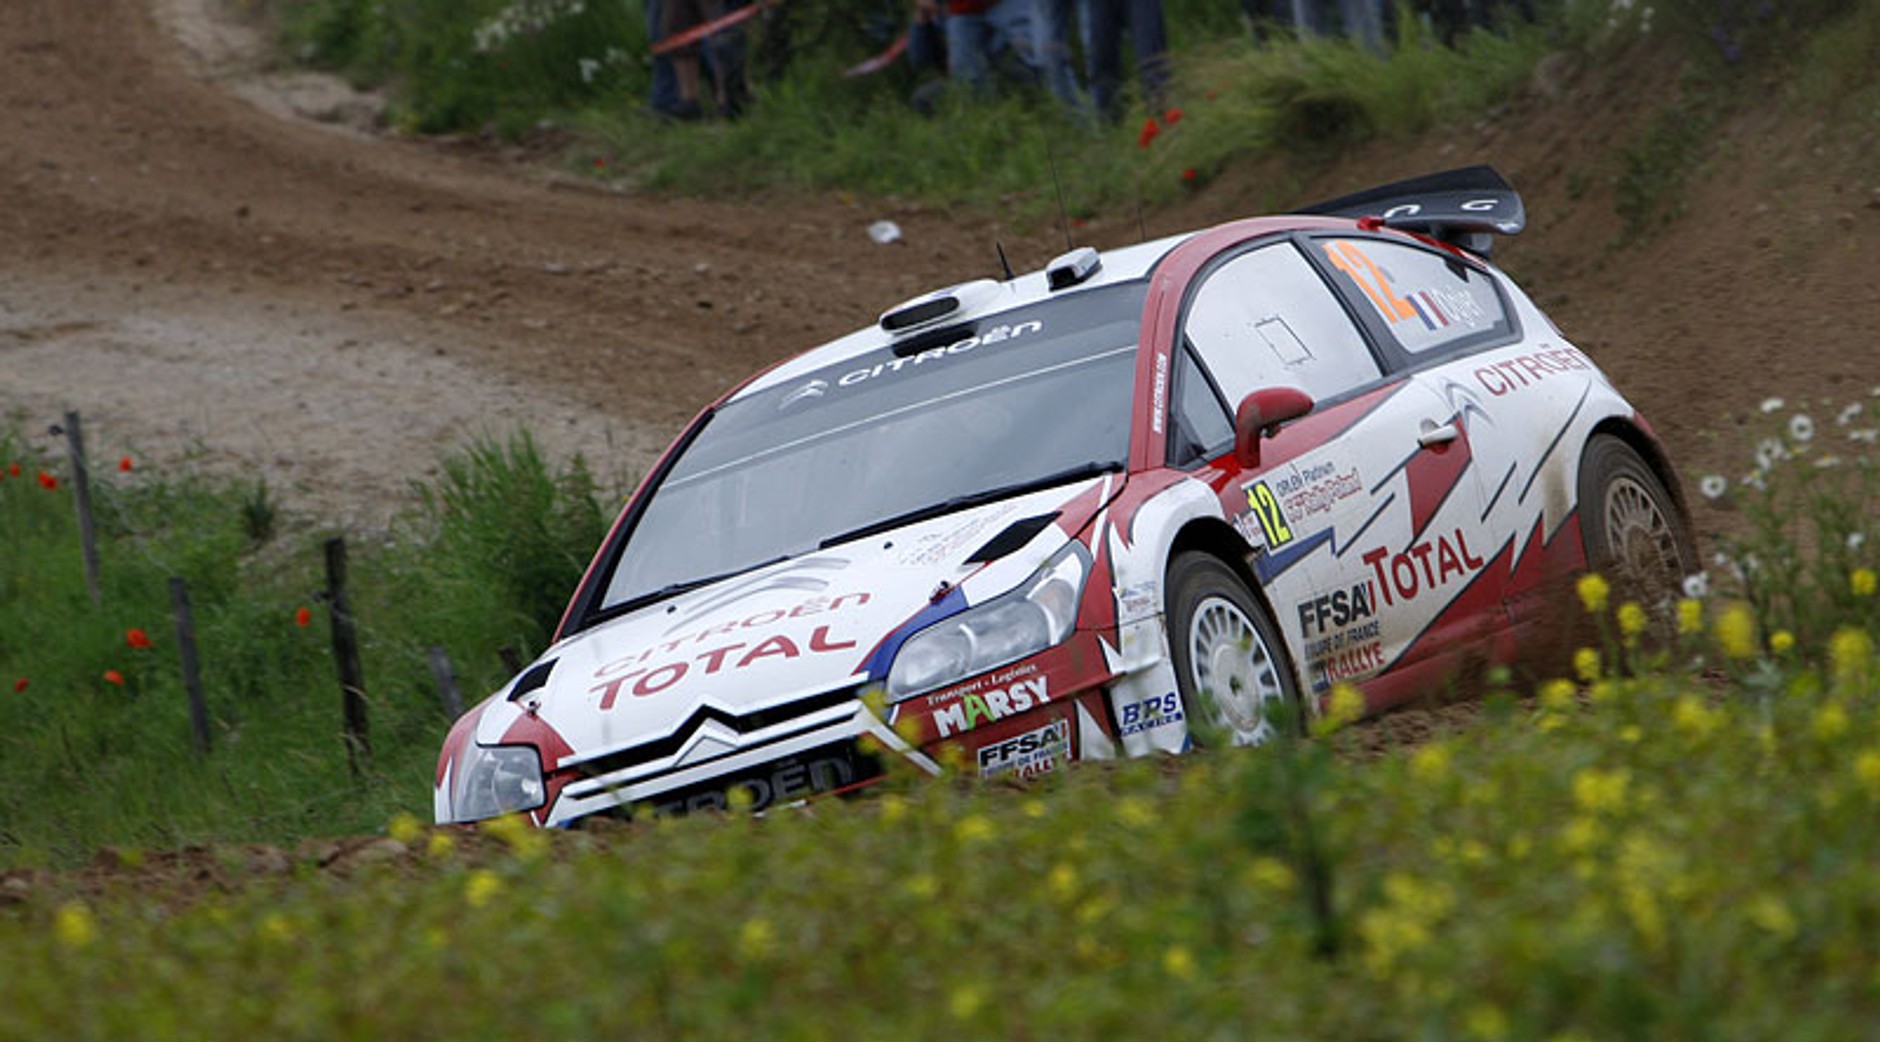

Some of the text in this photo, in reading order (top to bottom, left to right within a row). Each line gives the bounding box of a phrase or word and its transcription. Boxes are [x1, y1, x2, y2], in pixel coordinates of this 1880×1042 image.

[1322, 240, 1420, 324] 12
[839, 320, 1043, 388] CITROËN
[1246, 482, 1293, 547] 12
[1362, 527, 1484, 607] TOTAL
[593, 591, 871, 678] CITROËN
[1297, 584, 1371, 639] FFSA
[588, 625, 857, 710] TOTAL
[925, 681, 982, 706] Transport
[1327, 640, 1387, 684] RALLYE
[933, 675, 1051, 738] MARSY
[1122, 692, 1177, 726] BPS
[980, 725, 1060, 767] FFSA
